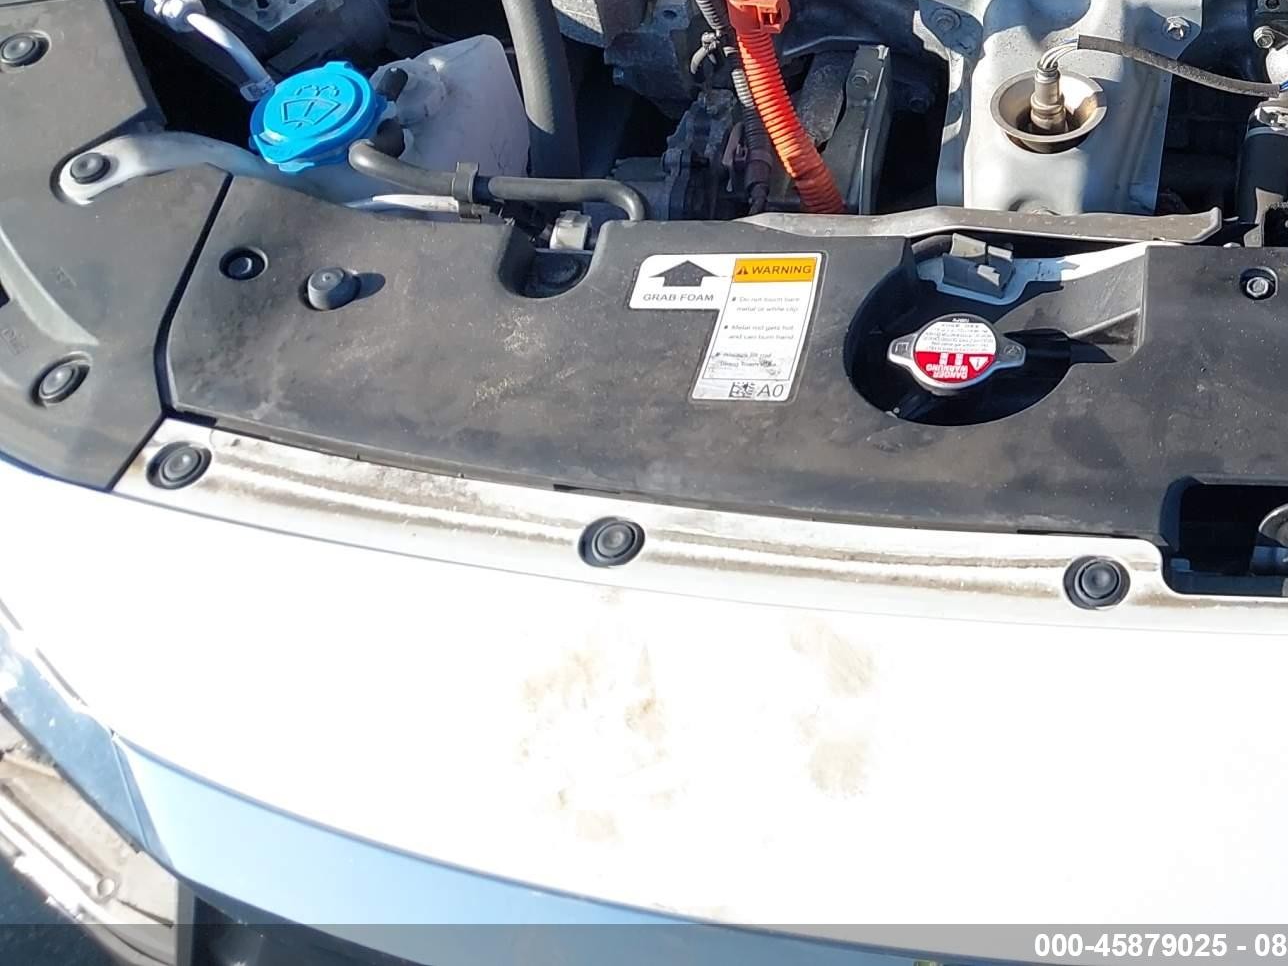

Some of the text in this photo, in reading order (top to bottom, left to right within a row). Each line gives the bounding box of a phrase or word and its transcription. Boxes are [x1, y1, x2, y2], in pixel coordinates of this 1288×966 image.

[751, 264, 813, 276] WARNING
[642, 292, 715, 303] GRAB FOAM
[756, 383, 785, 398] A0
